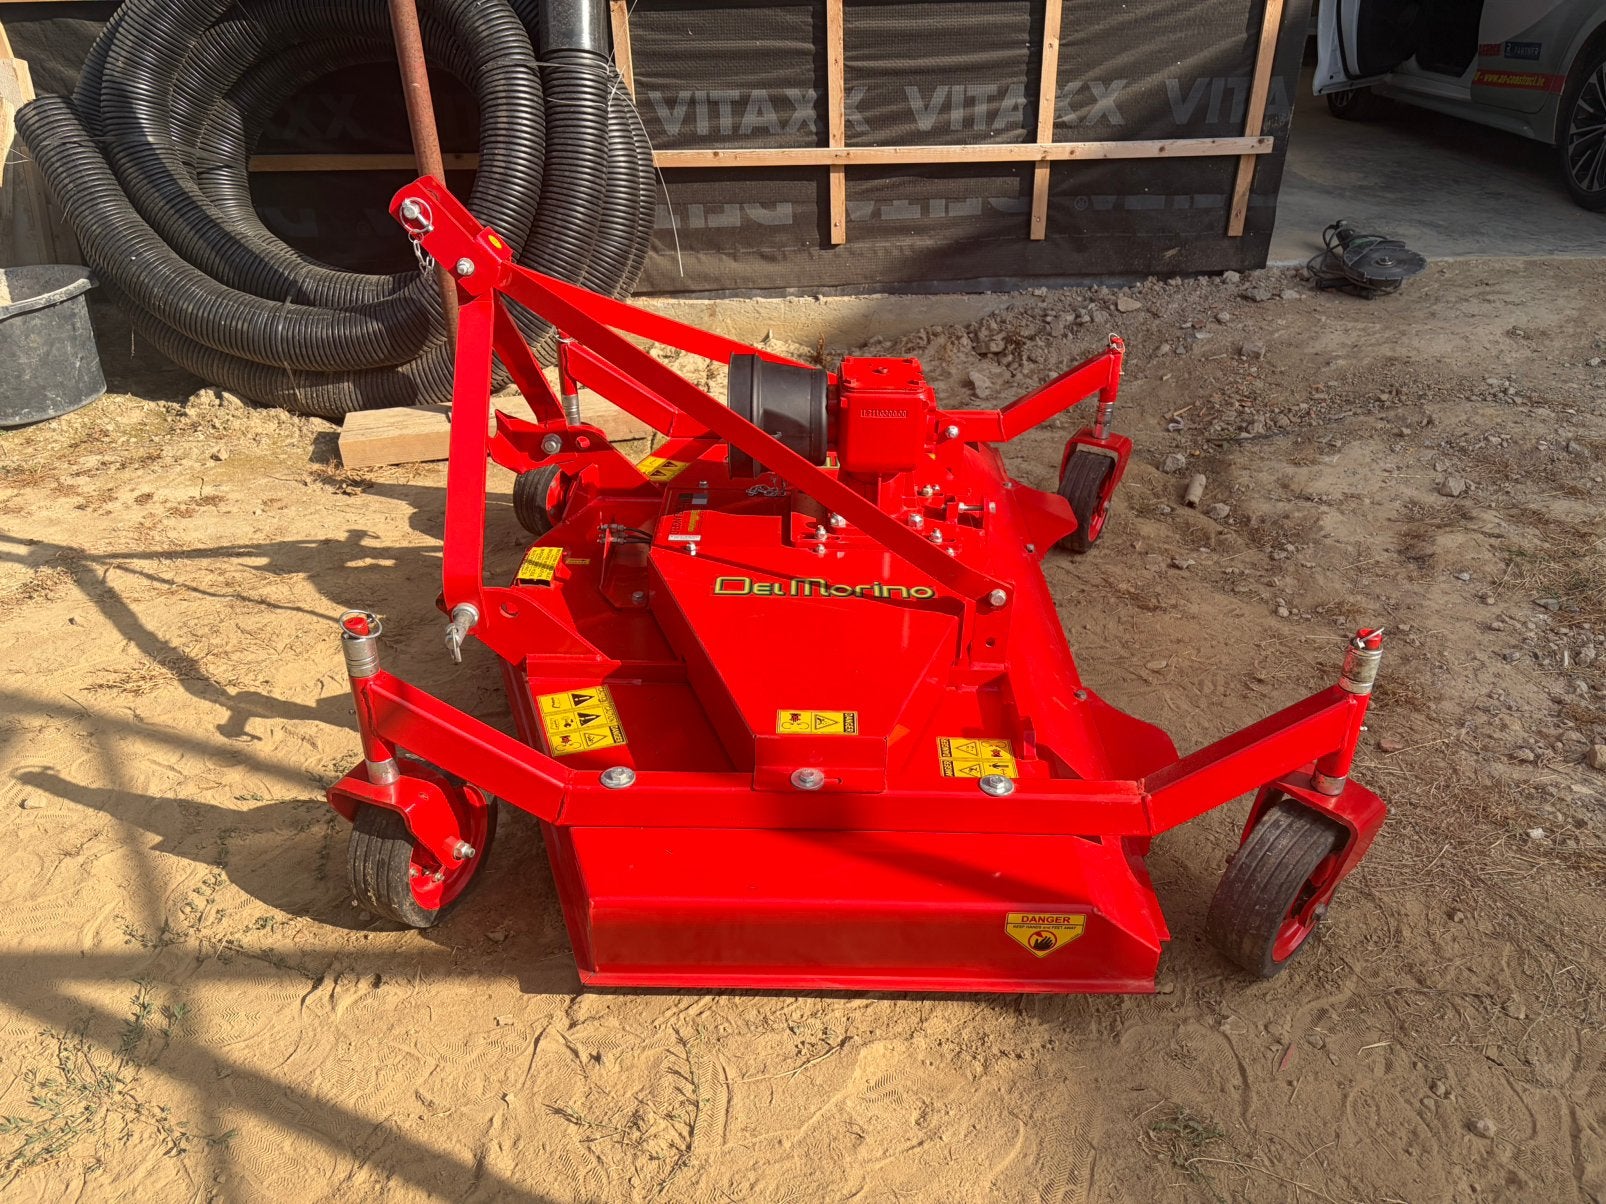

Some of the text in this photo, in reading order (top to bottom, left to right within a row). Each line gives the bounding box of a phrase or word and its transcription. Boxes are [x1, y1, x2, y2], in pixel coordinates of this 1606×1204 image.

[843, 712, 855, 733] DANGER
[943, 761, 954, 776] ANGER
[1021, 915, 1071, 924] DANGER
